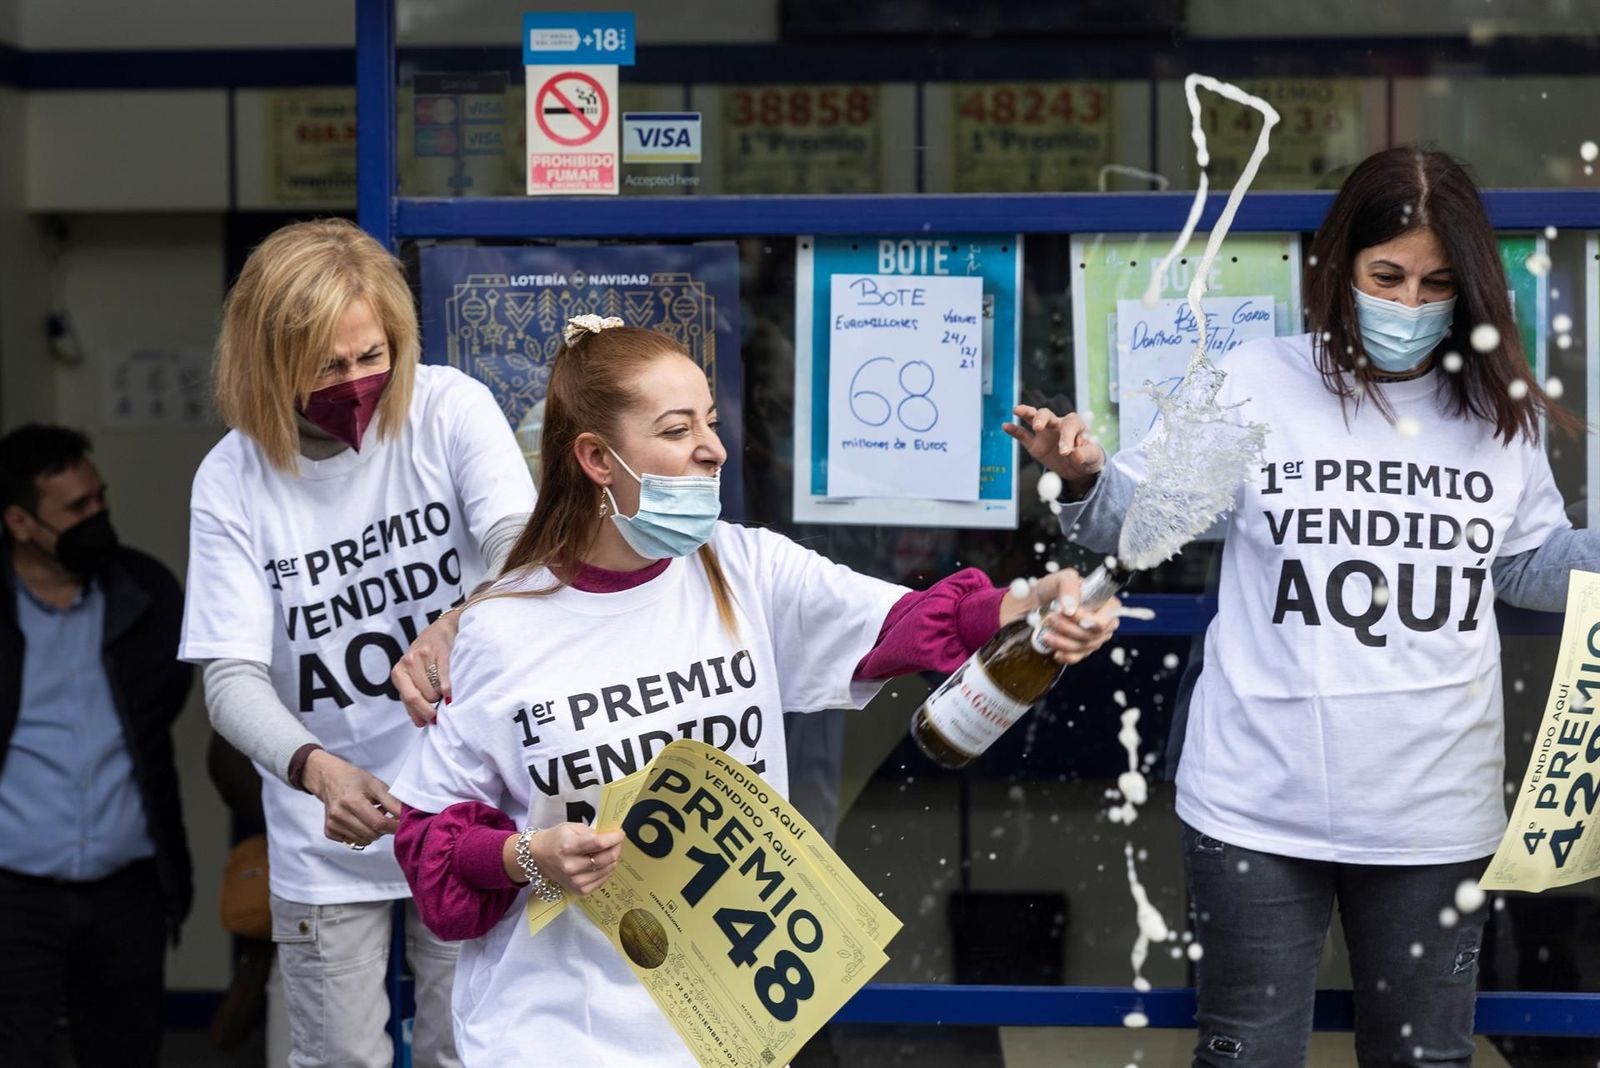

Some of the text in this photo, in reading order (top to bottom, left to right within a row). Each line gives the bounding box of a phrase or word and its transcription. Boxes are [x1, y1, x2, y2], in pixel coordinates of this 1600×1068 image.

[582, 28, 619, 51] +18
[731, 90, 872, 128] 38858
[957, 89, 1105, 126] 48243
[633, 127, 692, 148] VISA
[532, 154, 613, 168] PROHIBIDO
[546, 168, 599, 182] FUMAR
[625, 173, 674, 187] Accepted
[676, 173, 700, 186] here
[510, 272, 568, 287] LOTERÍA
[589, 274, 649, 286] NAVIDAD
[878, 240, 950, 275] BOTE
[849, 278, 926, 307] BOTE
[849, 357, 939, 432] 68
[894, 437, 907, 449] de
[1260, 459, 1494, 504] 1er PREMIO
[264, 501, 451, 592] 1er PREMIO
[1263, 508, 1495, 555] VENDIDO
[280, 547, 462, 642] VENDIDO
[1272, 558, 1487, 648] AQUÍ
[300, 595, 465, 712] AQ
[512, 649, 757, 748] 1er PREMIO
[1528, 683, 1571, 793] VENDIDO AQUÍ
[705, 752, 769, 805] VENDIDO
[770, 806, 807, 840] AQUÍ
[705, 769, 798, 867] VENDIDO AQUÍ
[648, 768, 824, 954] PREMIO
[683, 992, 693, 1004] DE
[691, 1004, 724, 1048] DICIEMBRE
[723, 1048, 739, 1067] 2021
